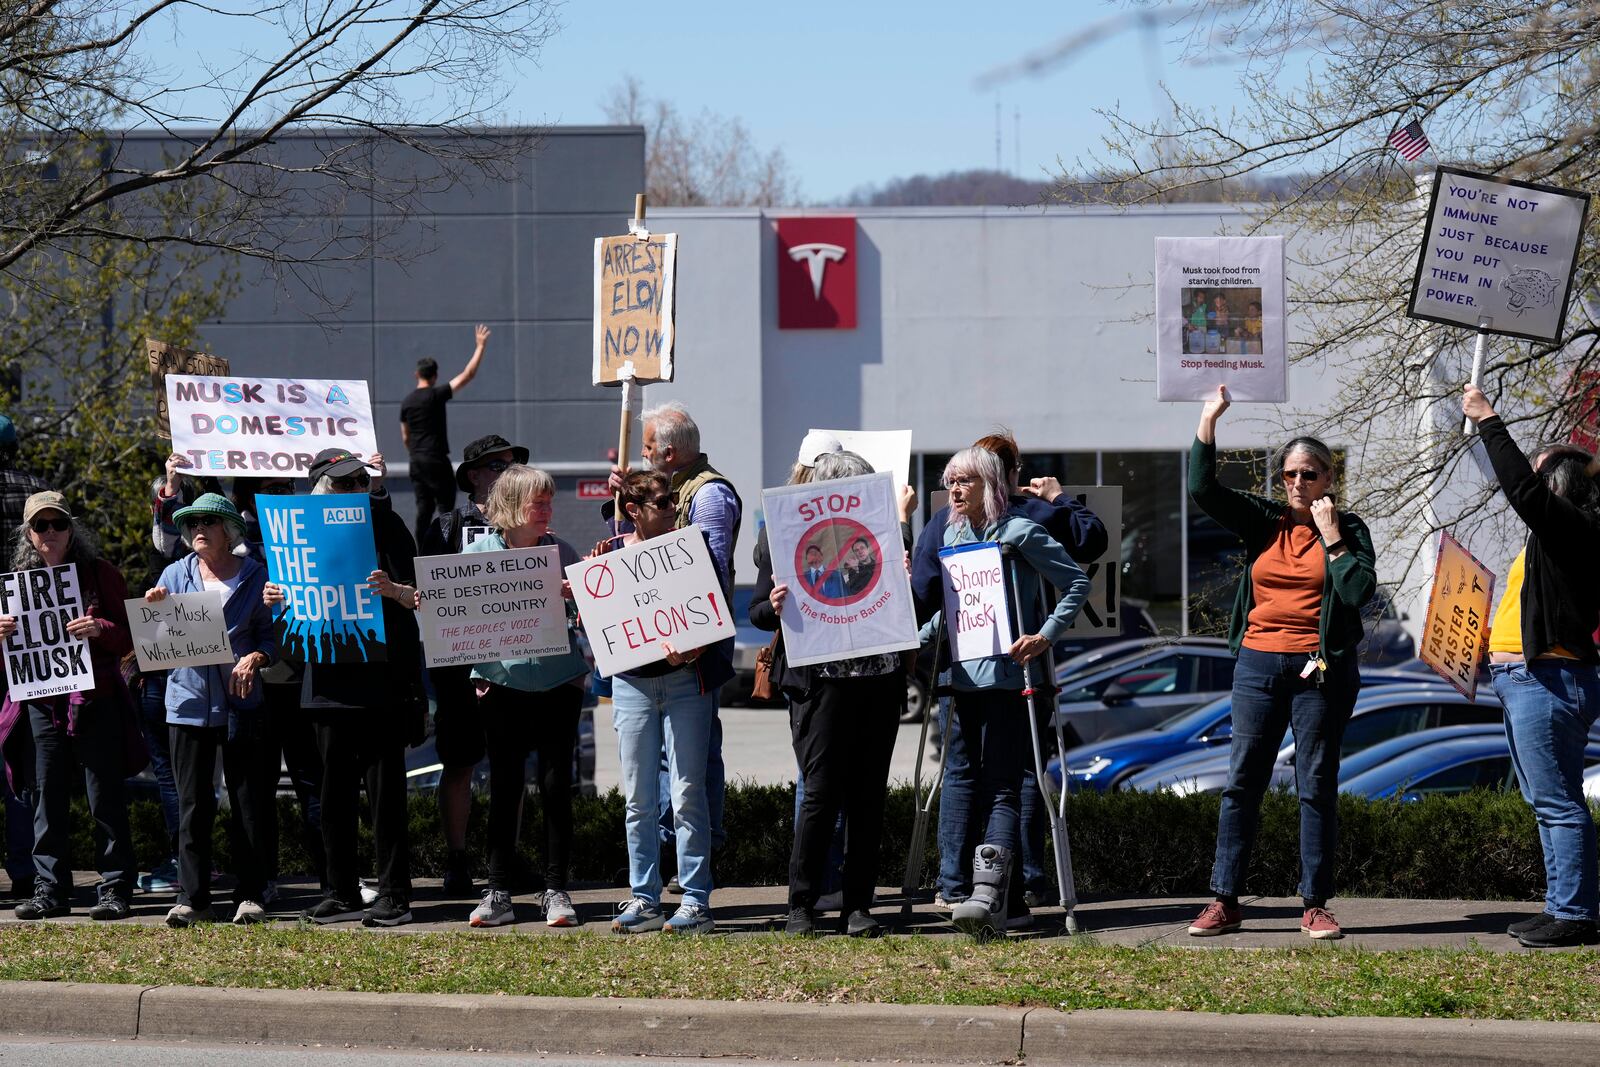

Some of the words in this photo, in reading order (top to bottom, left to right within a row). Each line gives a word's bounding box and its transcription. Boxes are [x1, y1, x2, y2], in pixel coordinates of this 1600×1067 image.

[1450, 186, 1498, 205] YOU'RE
[1507, 198, 1539, 213] NOT
[1443, 206, 1499, 226] IMMUNE
[1439, 227, 1475, 243] JUST
[1484, 235, 1549, 255] BECAUSE
[602, 241, 668, 280] ARREST
[1182, 266, 1203, 275] Musk
[1204, 266, 1221, 275] took
[1222, 266, 1240, 275] food
[1241, 266, 1261, 275] from
[1436, 248, 1464, 262] YOU
[1473, 255, 1501, 269] PUT
[1188, 277, 1220, 287] starving
[1220, 277, 1254, 286] children.
[1431, 268, 1469, 284] THEM
[1478, 277, 1493, 289] IN
[610, 273, 668, 317] ELON
[1426, 288, 1478, 307] POWER.
[605, 325, 665, 368] NOW
[1181, 360, 1203, 370] Stop
[1204, 359, 1238, 371] feeding
[1239, 360, 1266, 370] Musk.
[176, 382, 265, 404] MUSK
[277, 384, 307, 404] IS
[325, 384, 350, 405] A
[190, 413, 359, 437] DOMESTIC
[187, 449, 363, 471] TERROR
[326, 509, 363, 523] ACLU
[798, 494, 862, 522] STOP
[264, 507, 308, 545] WE
[270, 545, 320, 584] THE
[431, 564, 482, 581] tRUMP
[485, 561, 496, 574] &
[500, 556, 548, 573] fELON
[620, 537, 694, 583] VOTES
[0, 565, 77, 615] FIRE
[419, 588, 447, 601] ARE
[454, 579, 544, 598] DESTROYING
[949, 563, 1001, 593] Shame
[278, 583, 374, 622] PEOPLE
[436, 605, 467, 618] OUR
[481, 598, 548, 615] COUNTRY
[633, 588, 663, 608] FOR
[800, 602, 819, 619] The
[819, 613, 859, 625] Robber
[859, 591, 892, 618] Barons
[964, 591, 981, 607] ON
[6, 607, 83, 652] ELON
[165, 625, 187, 638] the
[441, 627, 460, 639] THE
[510, 617, 541, 630] VOICE
[601, 591, 724, 656] FELONS!
[1429, 613, 1447, 659] FAST
[142, 641, 186, 661] White
[186, 630, 227, 657] House!
[451, 640, 476, 652] WILL
[478, 638, 492, 649] BE
[499, 633, 533, 646] HEARD
[1443, 605, 1465, 672] FASTER
[1457, 606, 1480, 684] FASCIST
[9, 643, 89, 686] MUSK
[433, 654, 462, 666] brought
[463, 654, 477, 663] you
[478, 652, 487, 661] by
[488, 651, 501, 659] the
[511, 648, 523, 657] 1st
[523, 645, 568, 656] Amendment
[33, 684, 79, 697] INDIVISIBLE
